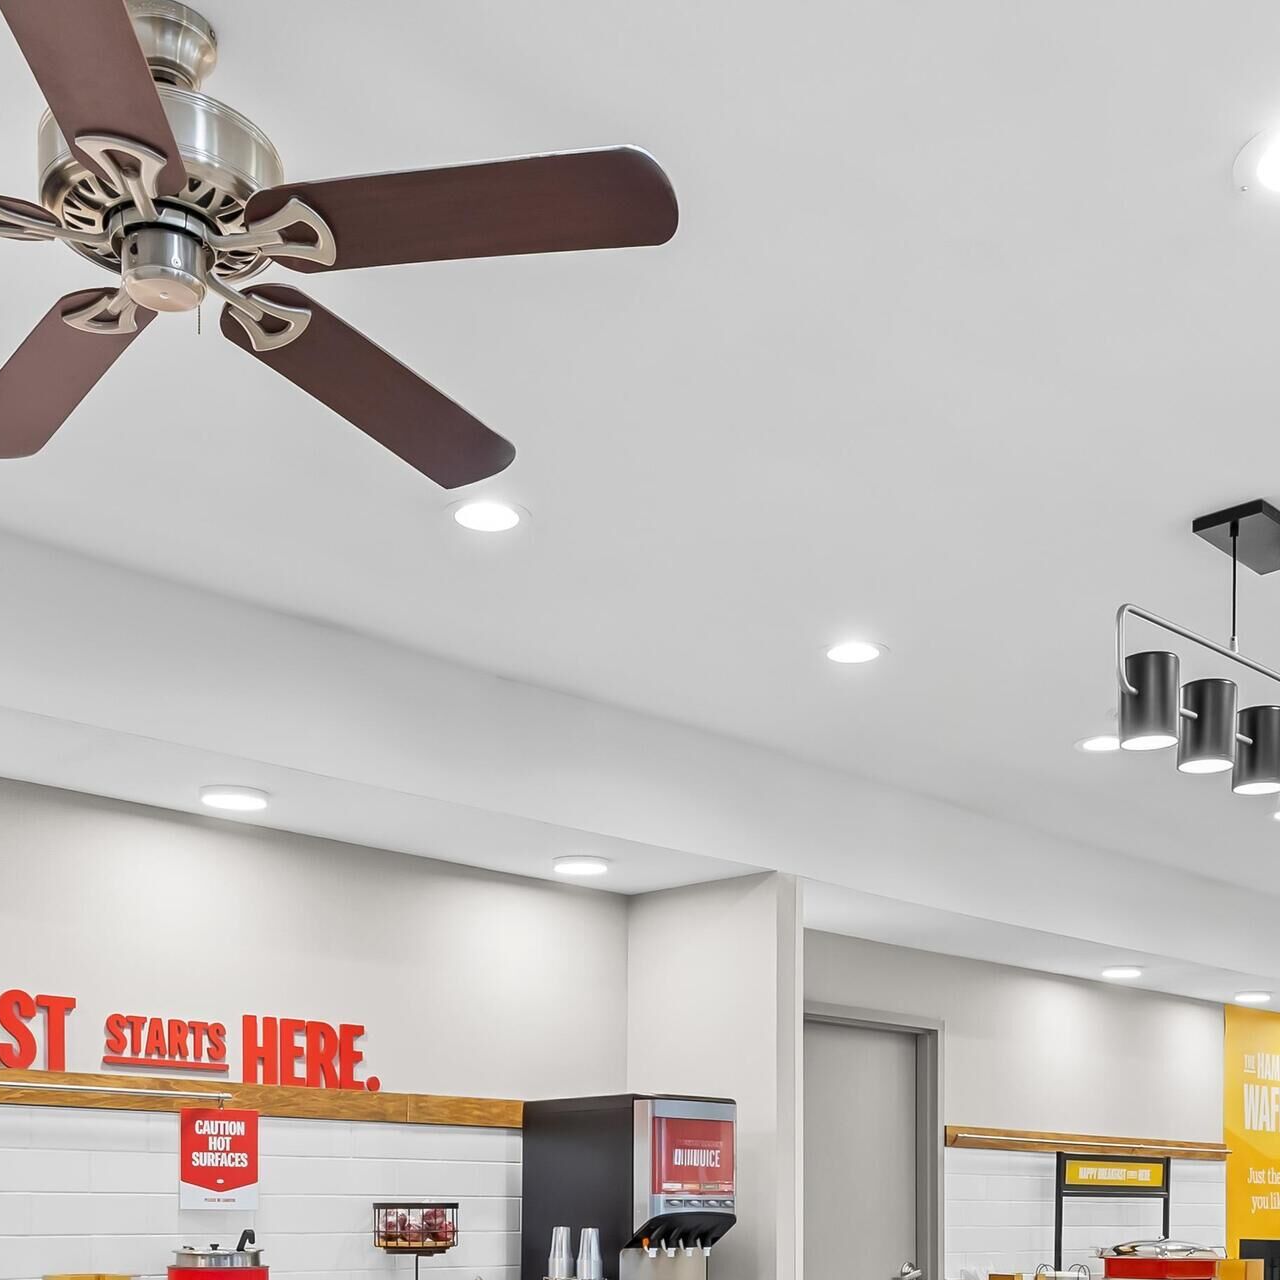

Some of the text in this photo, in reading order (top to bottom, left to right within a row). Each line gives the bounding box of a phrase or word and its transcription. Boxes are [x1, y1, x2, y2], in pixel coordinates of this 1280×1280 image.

[106, 1013, 226, 1061] STARTS
[242, 1014, 380, 1091] HERE.
[194, 1119, 246, 1136] CAUTION
[208, 1136, 232, 1151] HOT
[191, 1151, 249, 1168] SURFACES
[1247, 1167, 1266, 1184] Just
[1251, 1195, 1269, 1214] you
